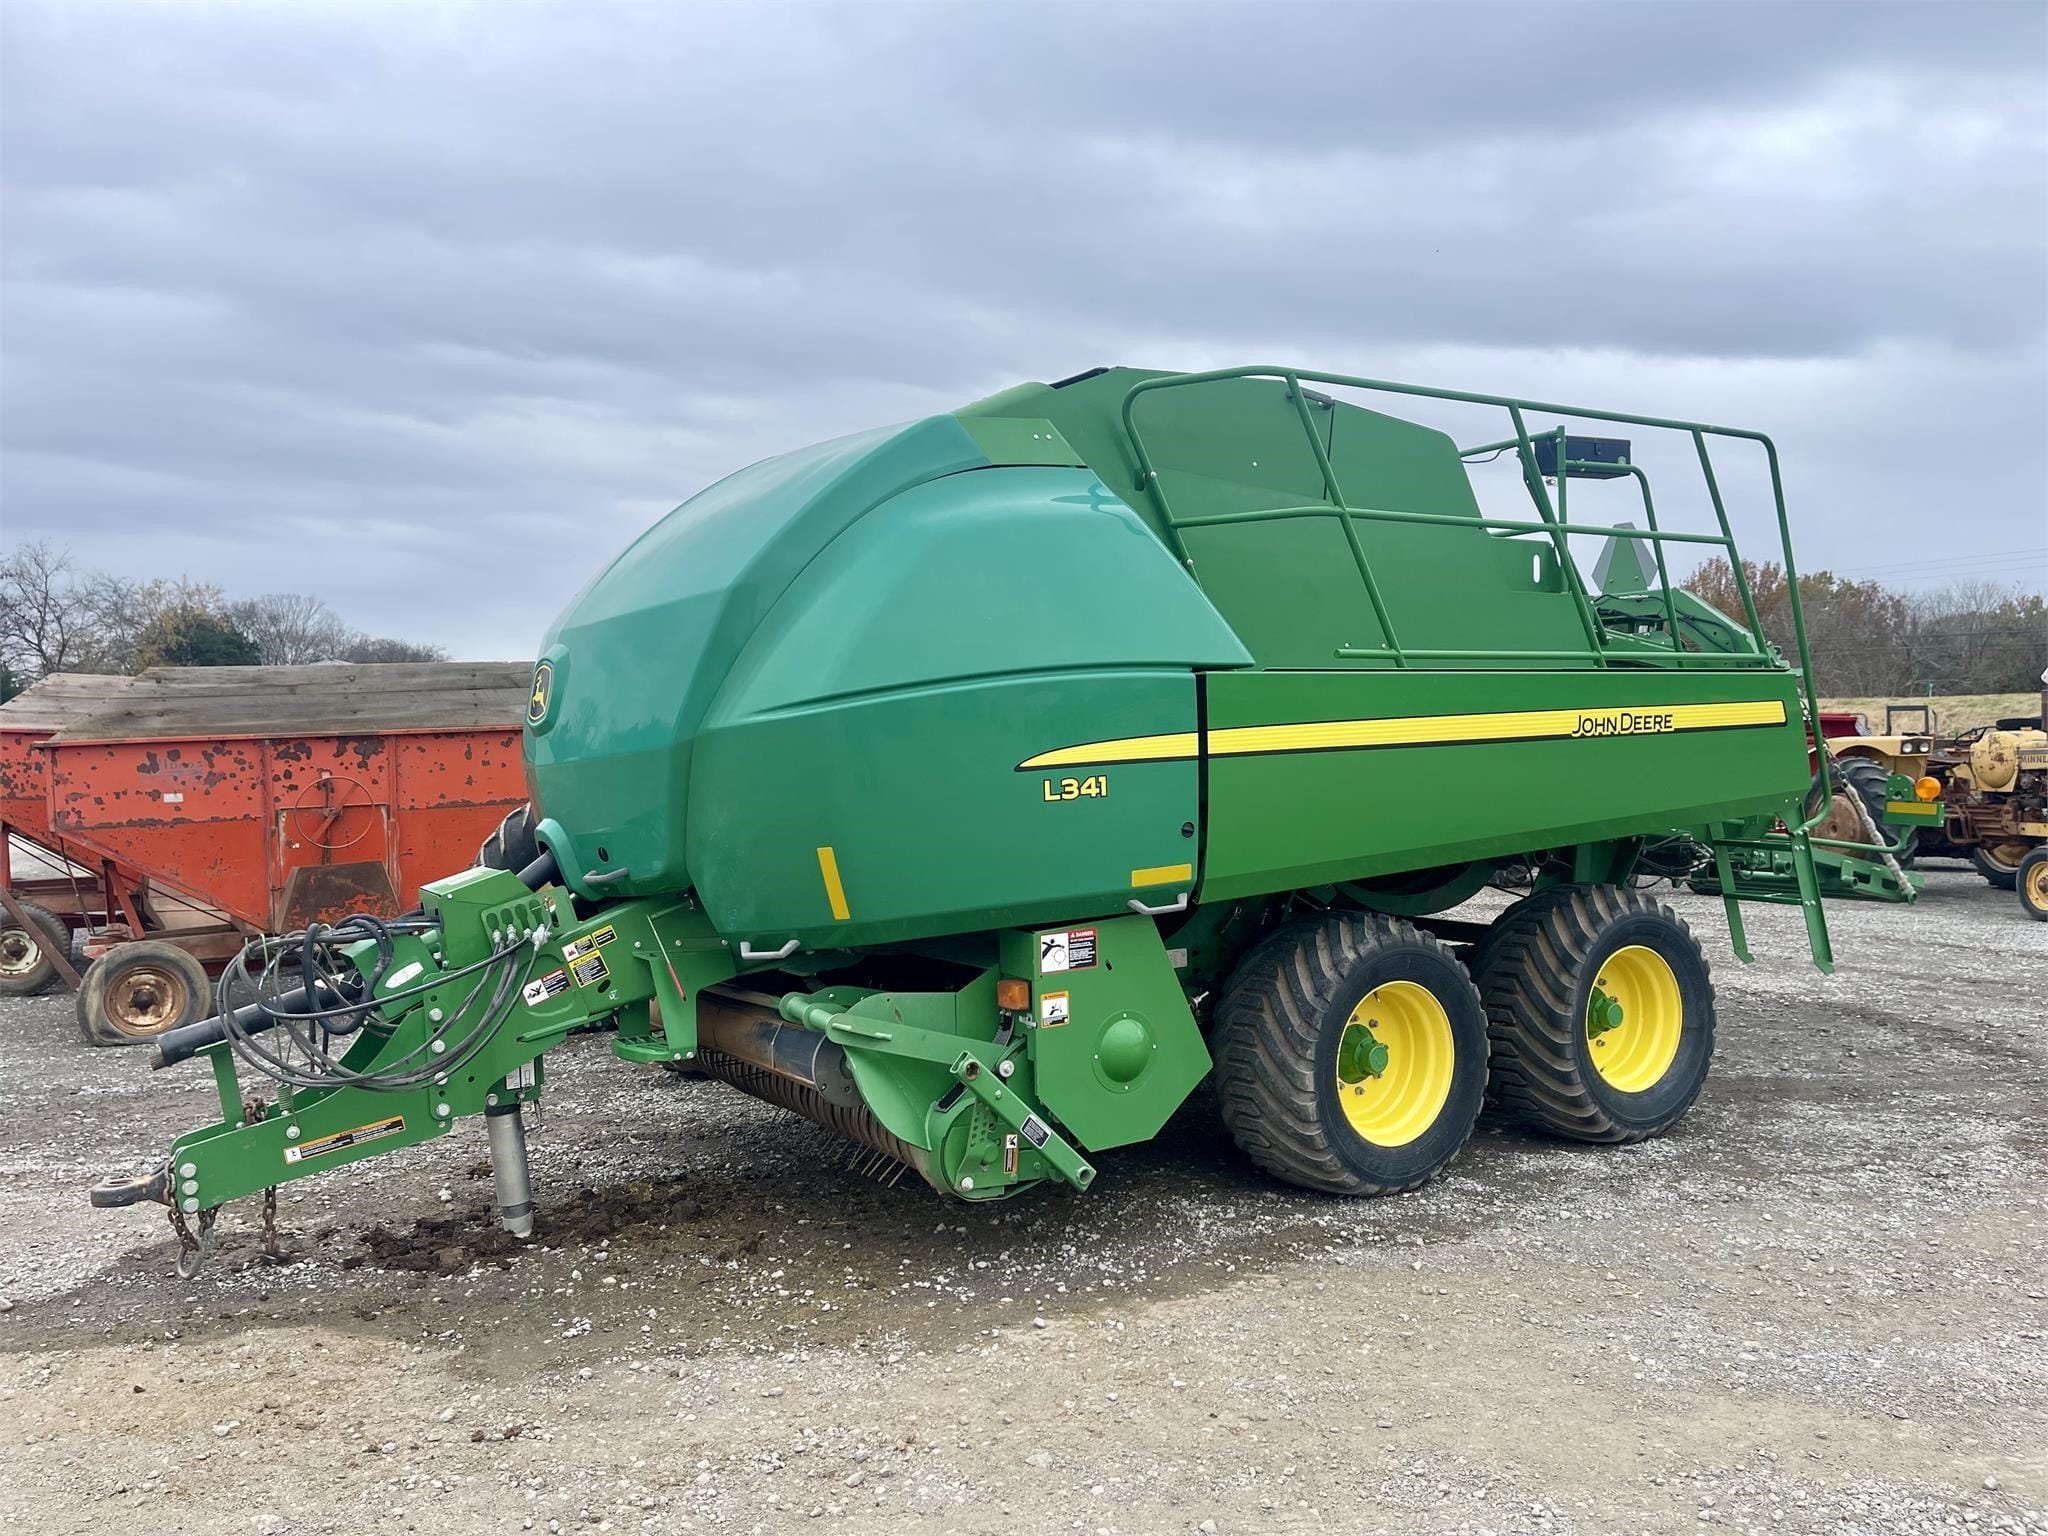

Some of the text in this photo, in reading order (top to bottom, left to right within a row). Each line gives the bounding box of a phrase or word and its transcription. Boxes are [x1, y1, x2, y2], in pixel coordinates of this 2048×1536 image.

[1572, 713, 1673, 734] JOHN DEERE
[1043, 775, 1107, 801] L341
